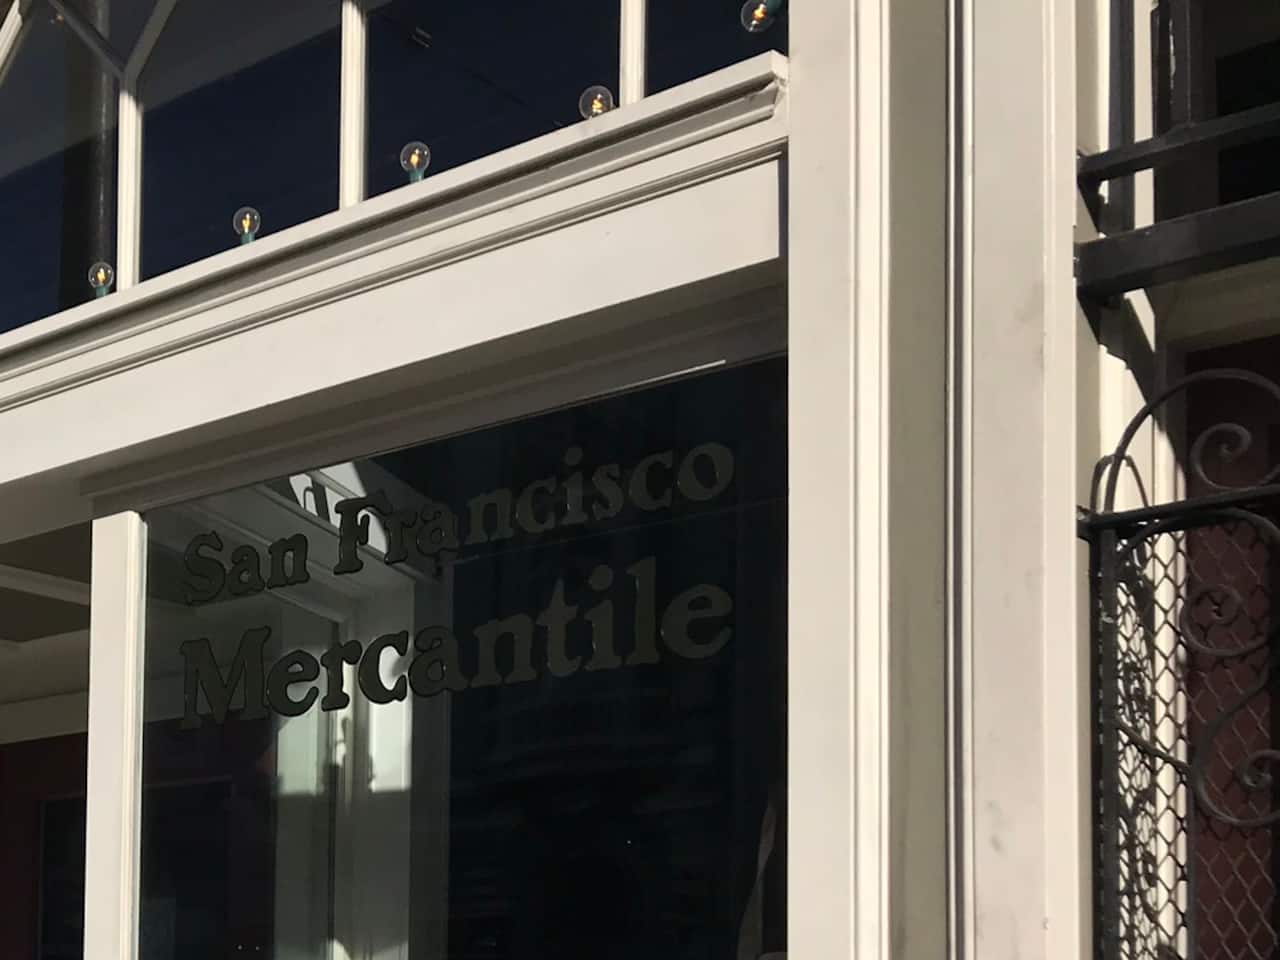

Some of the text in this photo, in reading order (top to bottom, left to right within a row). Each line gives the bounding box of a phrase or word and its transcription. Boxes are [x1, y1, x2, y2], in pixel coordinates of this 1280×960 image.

[183, 442, 736, 606] San Francisco
[180, 556, 735, 730] Mercantile
